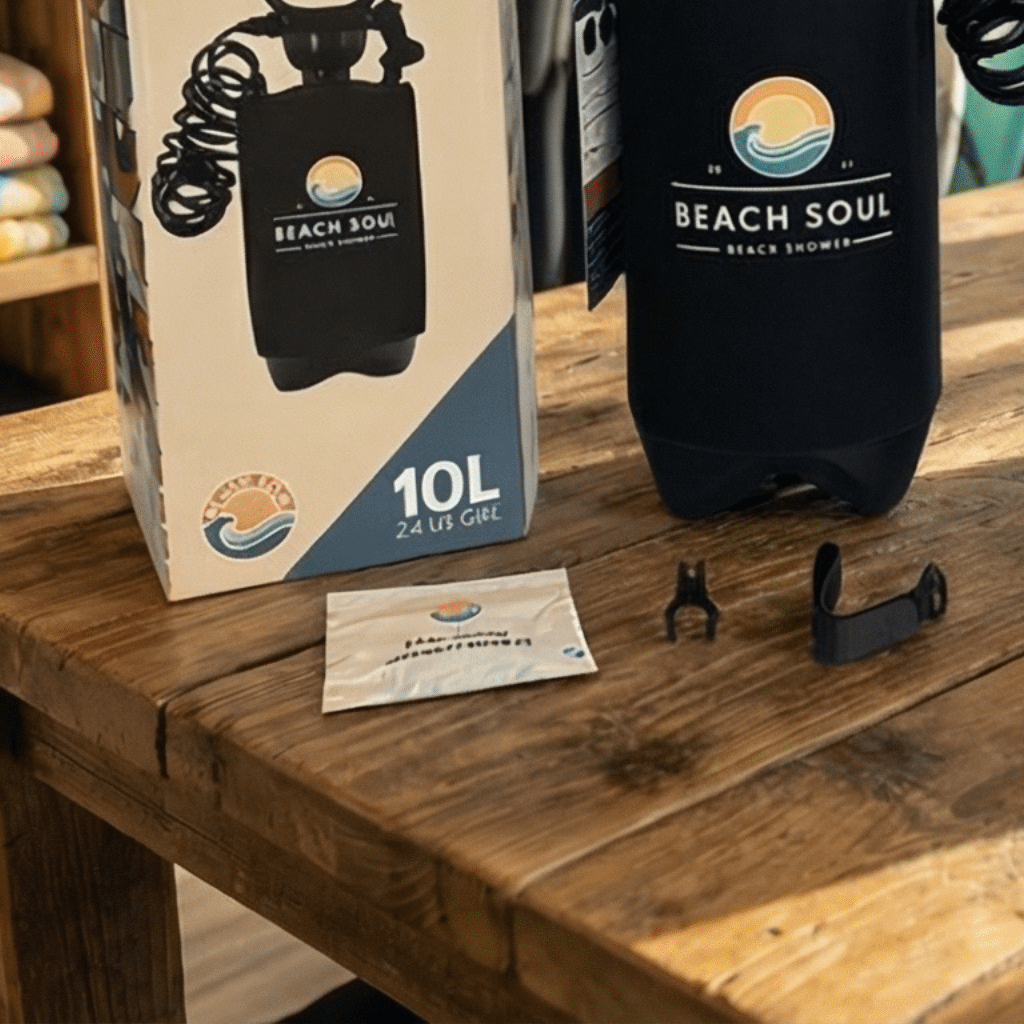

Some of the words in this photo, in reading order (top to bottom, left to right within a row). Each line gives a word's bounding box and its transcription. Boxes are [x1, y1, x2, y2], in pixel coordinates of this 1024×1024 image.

[674, 201, 789, 232] BEACH
[805, 192, 891, 229] SOUL
[393, 453, 501, 519] 10L
